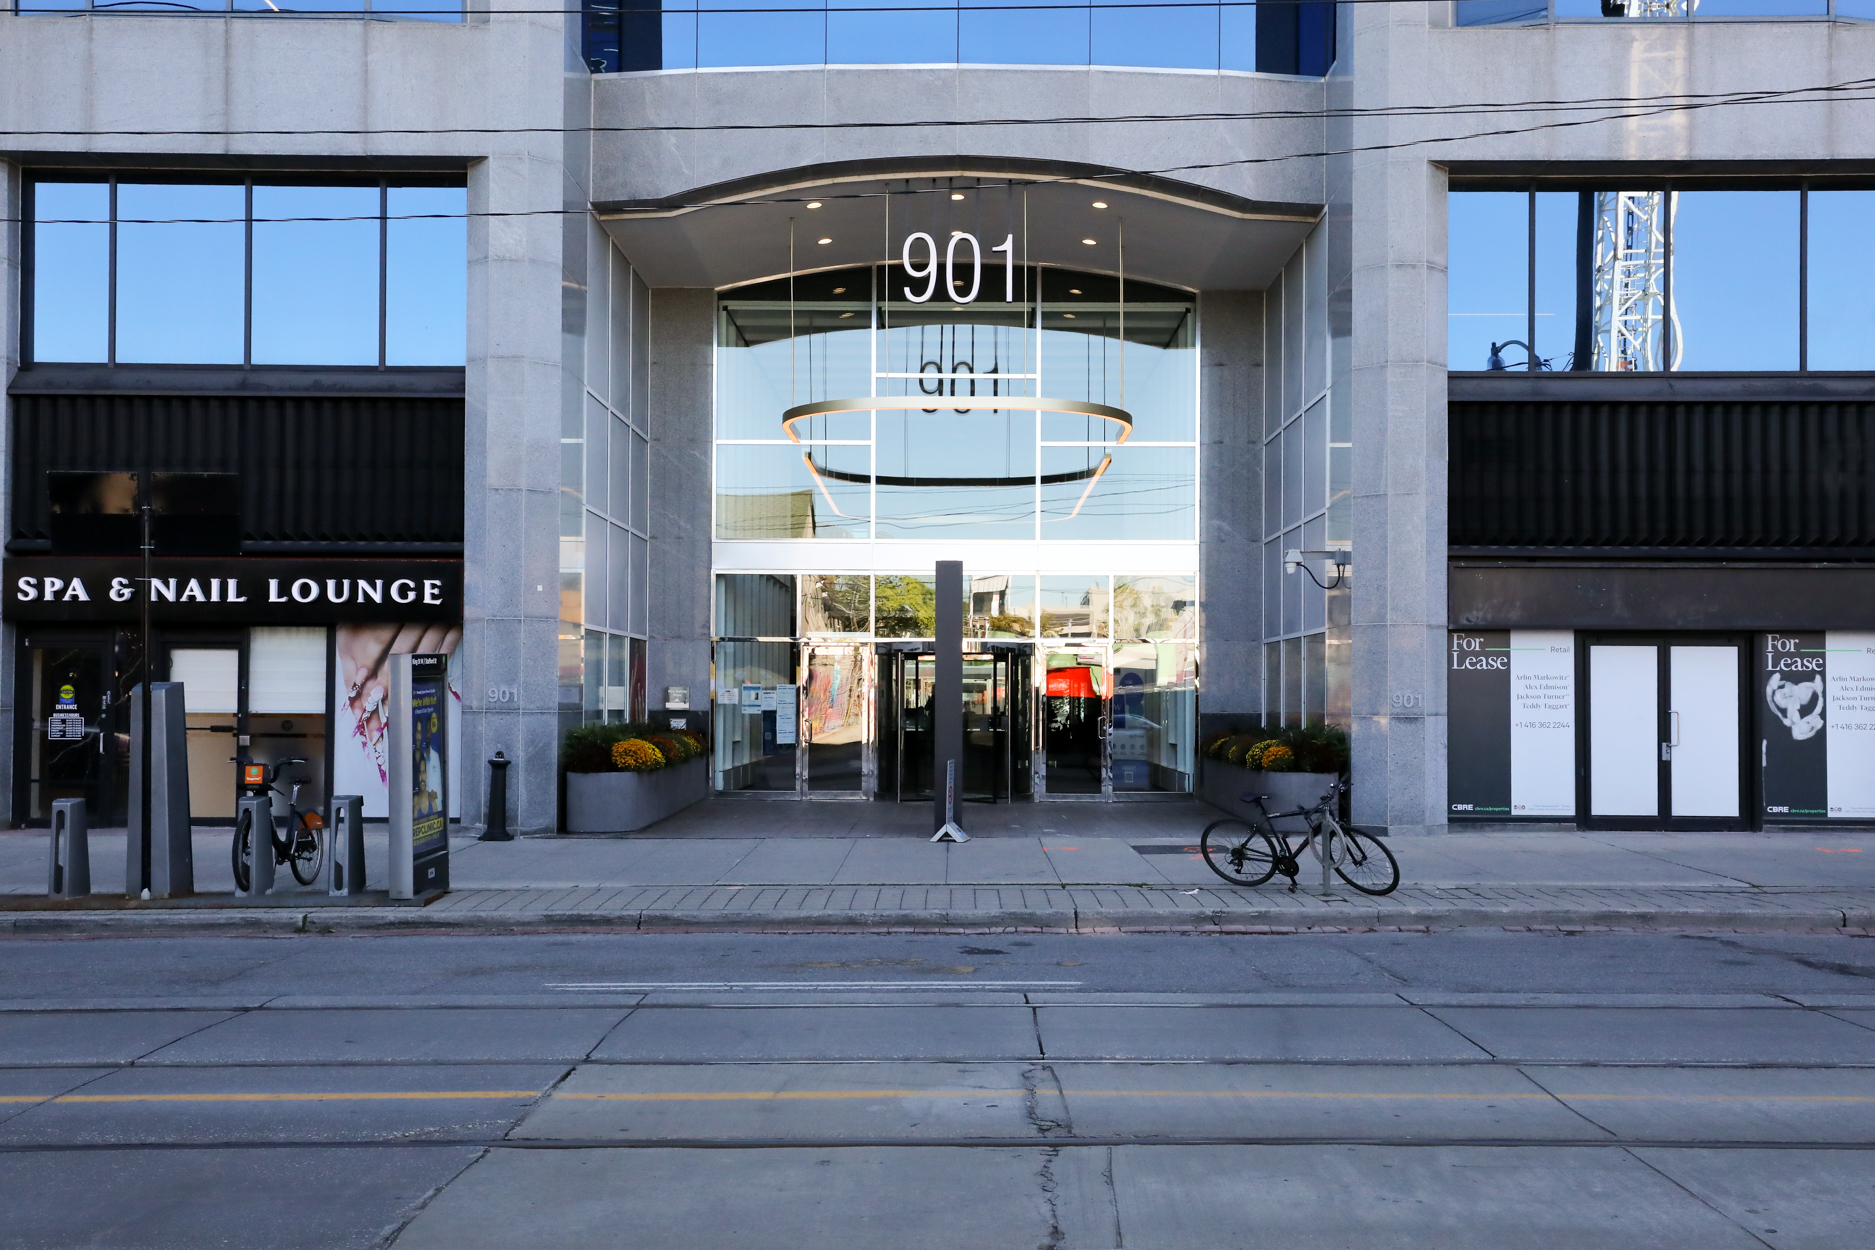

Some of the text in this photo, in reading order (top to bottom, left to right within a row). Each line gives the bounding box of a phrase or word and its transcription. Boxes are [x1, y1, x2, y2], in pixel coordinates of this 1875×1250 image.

[902, 231, 1014, 304] 901
[17, 576, 443, 605] SPA & NAIL LOUNGE
[1451, 632, 1485, 651] For
[1550, 646, 1571, 654] Retail
[1766, 633, 1800, 653] For
[1451, 651, 1509, 670] Lease
[1766, 652, 1824, 671] Lease
[488, 688, 518, 702] 901
[1391, 693, 1423, 708] 901
[1838, 704, 1858, 712] Teddy
[1523, 721, 1537, 729] 416
[1537, 721, 1552, 729] 362
[1552, 721, 1570, 729] 2244
